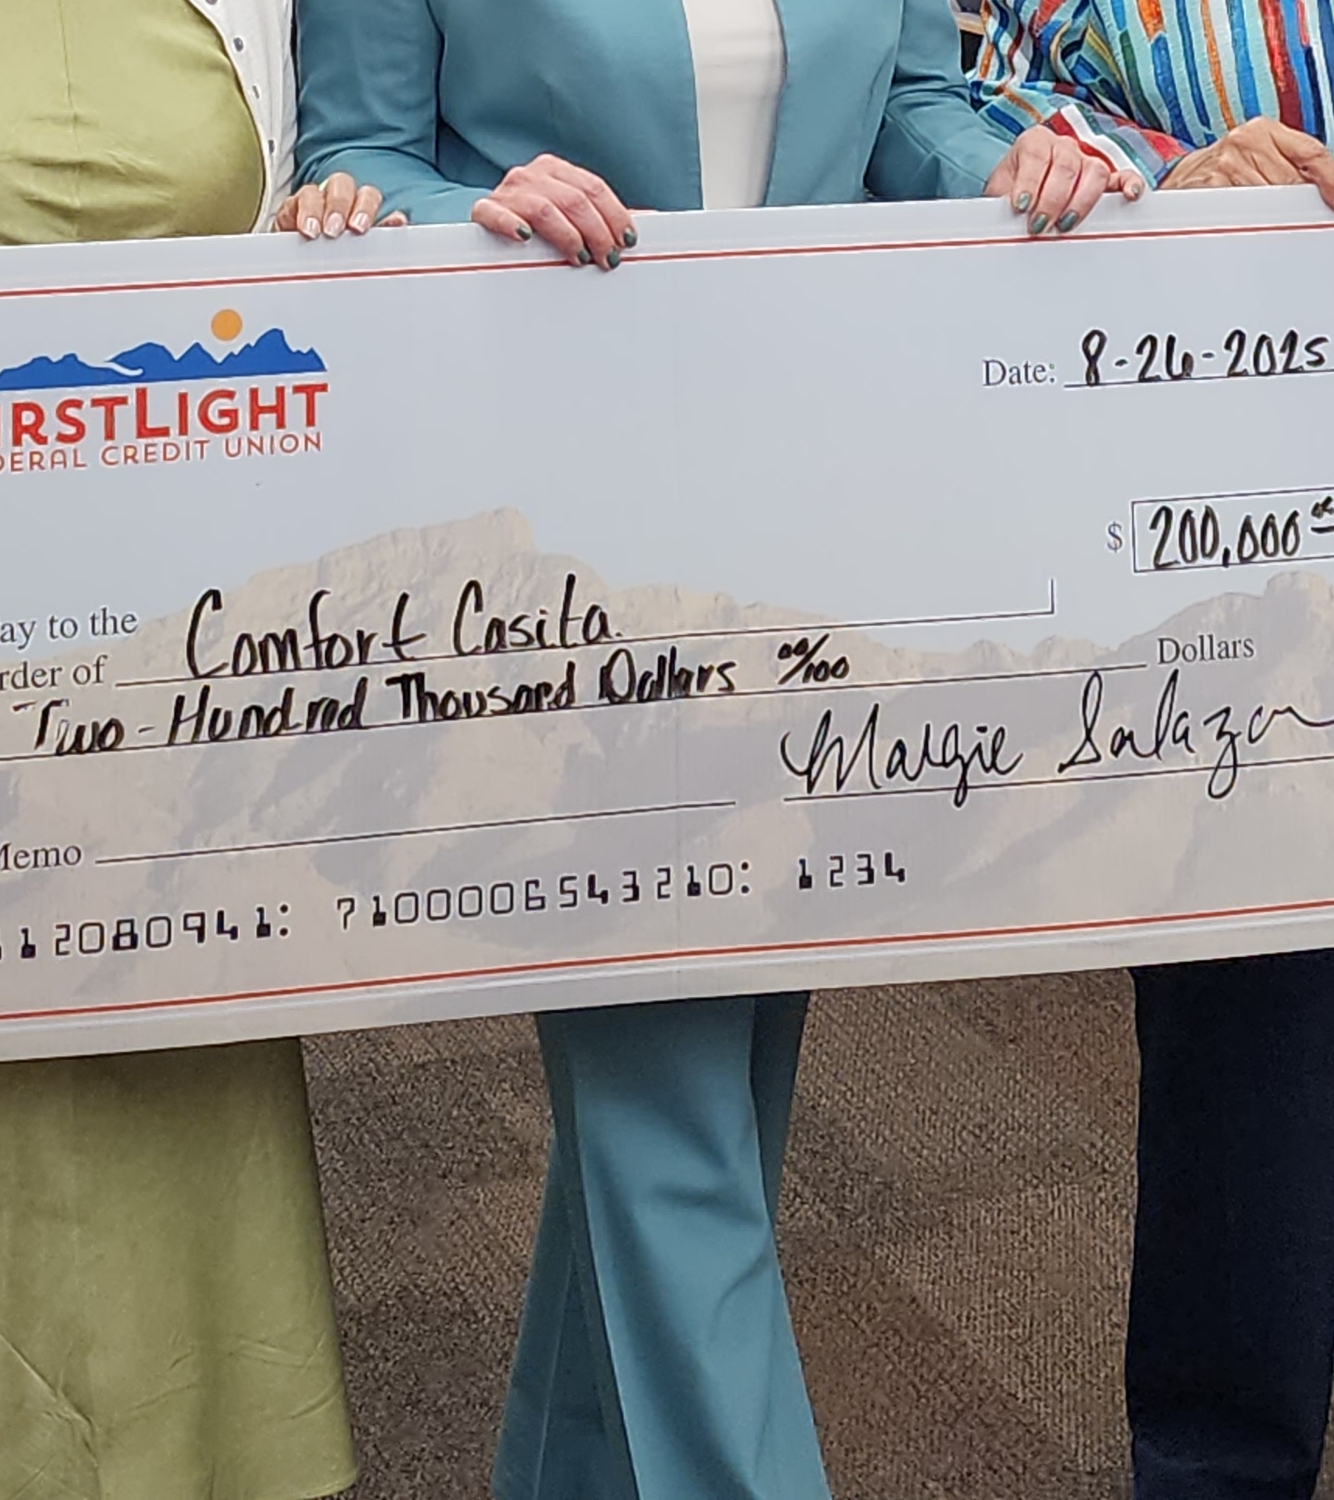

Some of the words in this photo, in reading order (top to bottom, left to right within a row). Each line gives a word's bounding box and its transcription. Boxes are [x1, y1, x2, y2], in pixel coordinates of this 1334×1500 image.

[981, 360, 1057, 388] Date:
[101, 440, 210, 467] CREDIT
[226, 432, 323, 458] UNION
[1106, 522, 1124, 552] $
[48, 615, 79, 640] to
[89, 608, 138, 637] the
[186, 588, 427, 680] Comfort
[1157, 635, 1255, 668] Dollars
[73, 655, 109, 686] of
[384, 660, 576, 722] Thousand
[798, 851, 907, 890] 1234
